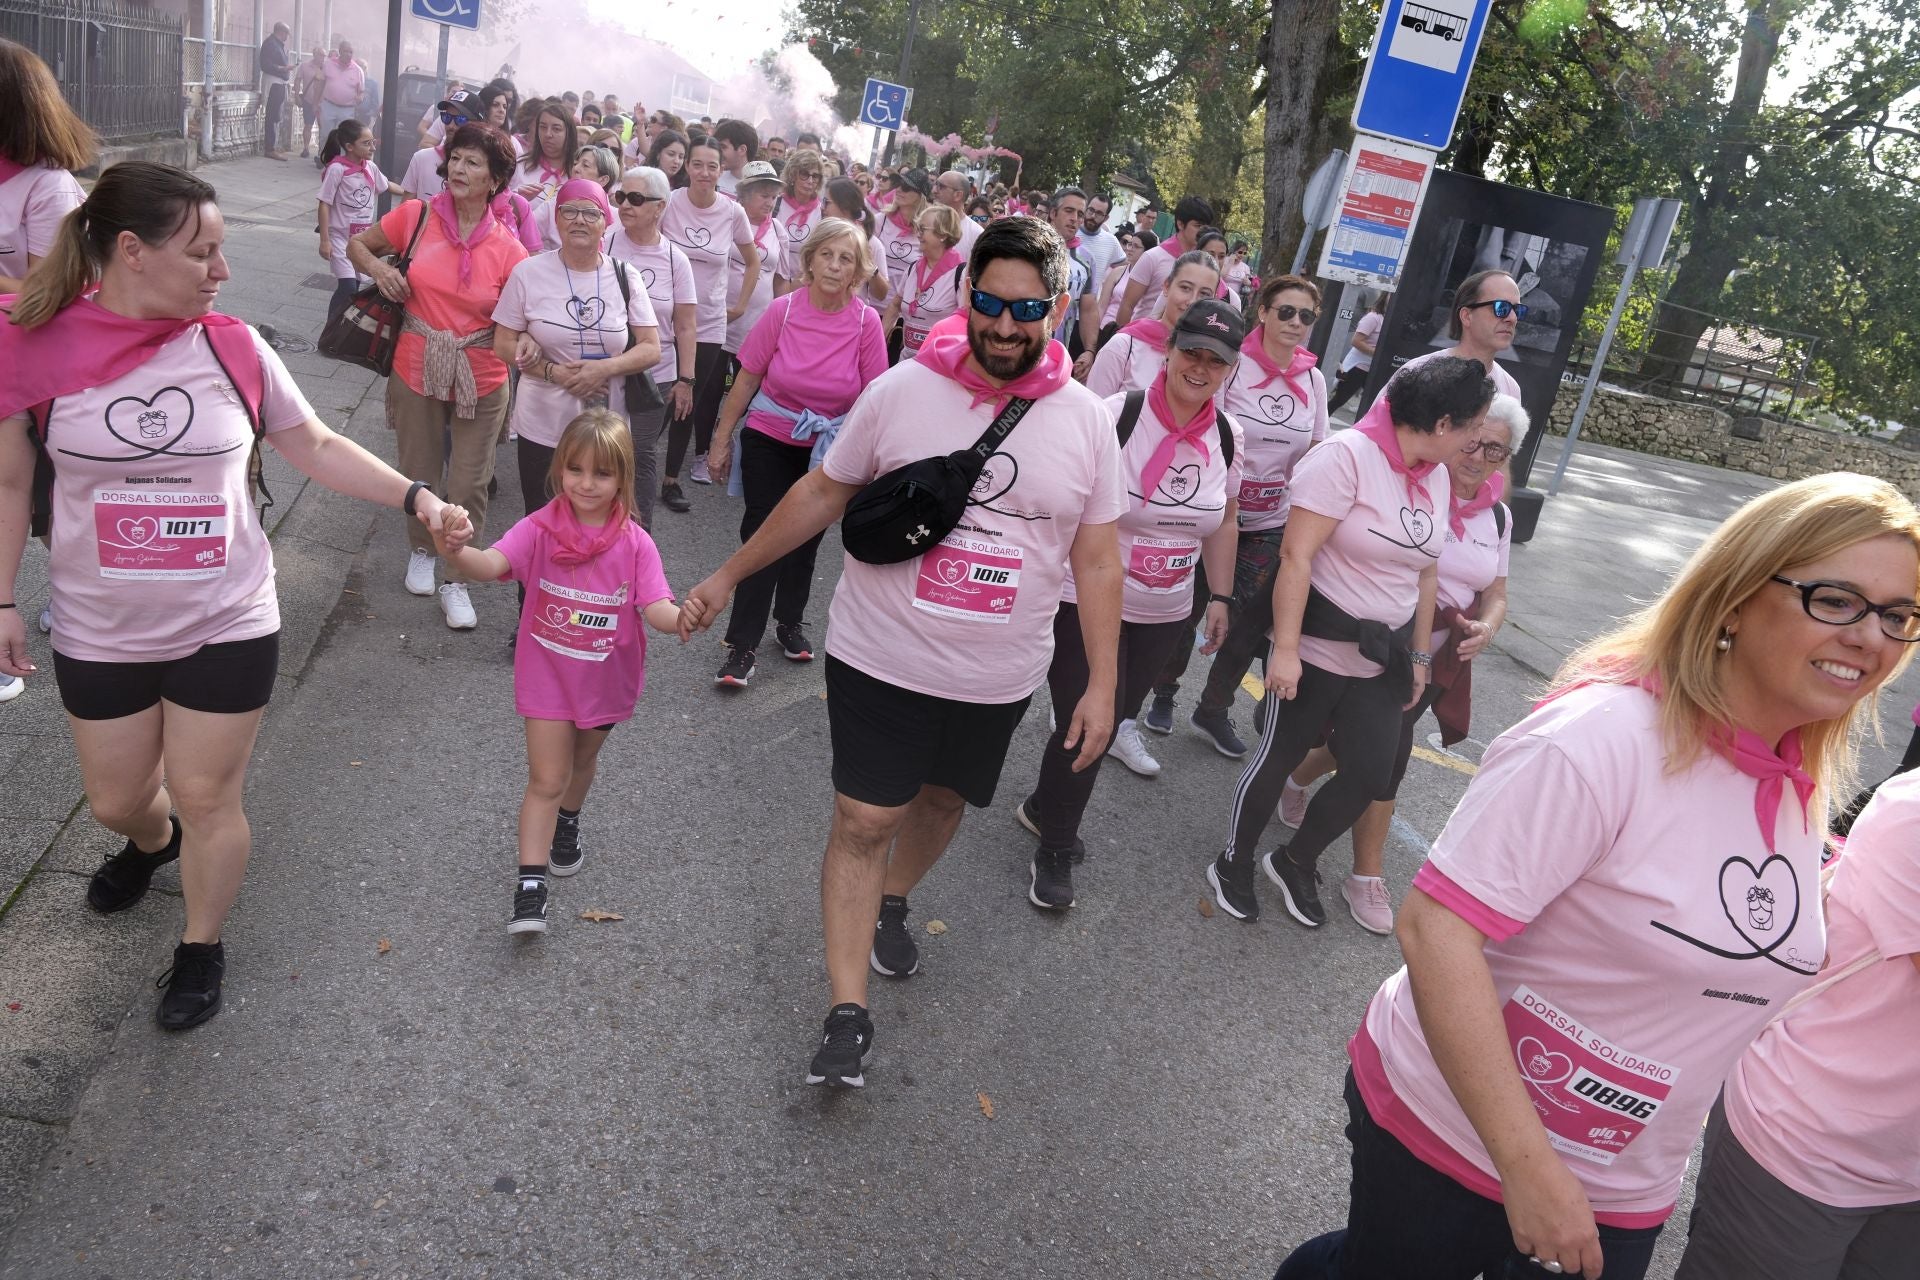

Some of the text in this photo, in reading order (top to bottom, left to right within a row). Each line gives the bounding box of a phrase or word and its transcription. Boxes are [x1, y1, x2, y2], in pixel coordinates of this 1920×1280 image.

[125, 476, 192, 485] Anjanas Solidarias
[102, 492, 220, 504] DORSAL SOLIDARIO
[166, 520, 212, 535] 1017
[940, 535, 1019, 557] ORSAL SOLIDARIO
[1137, 537, 1166, 547] DORSAL
[973, 567, 1010, 584] 1016
[542, 582, 618, 604] DORSAL SOLIDARIO
[1701, 988, 1770, 1006] Anjanas Solidarias
[1523, 994, 1672, 1081] DORSAL SOLIDARIO
[1573, 1077, 1657, 1119] 0896
